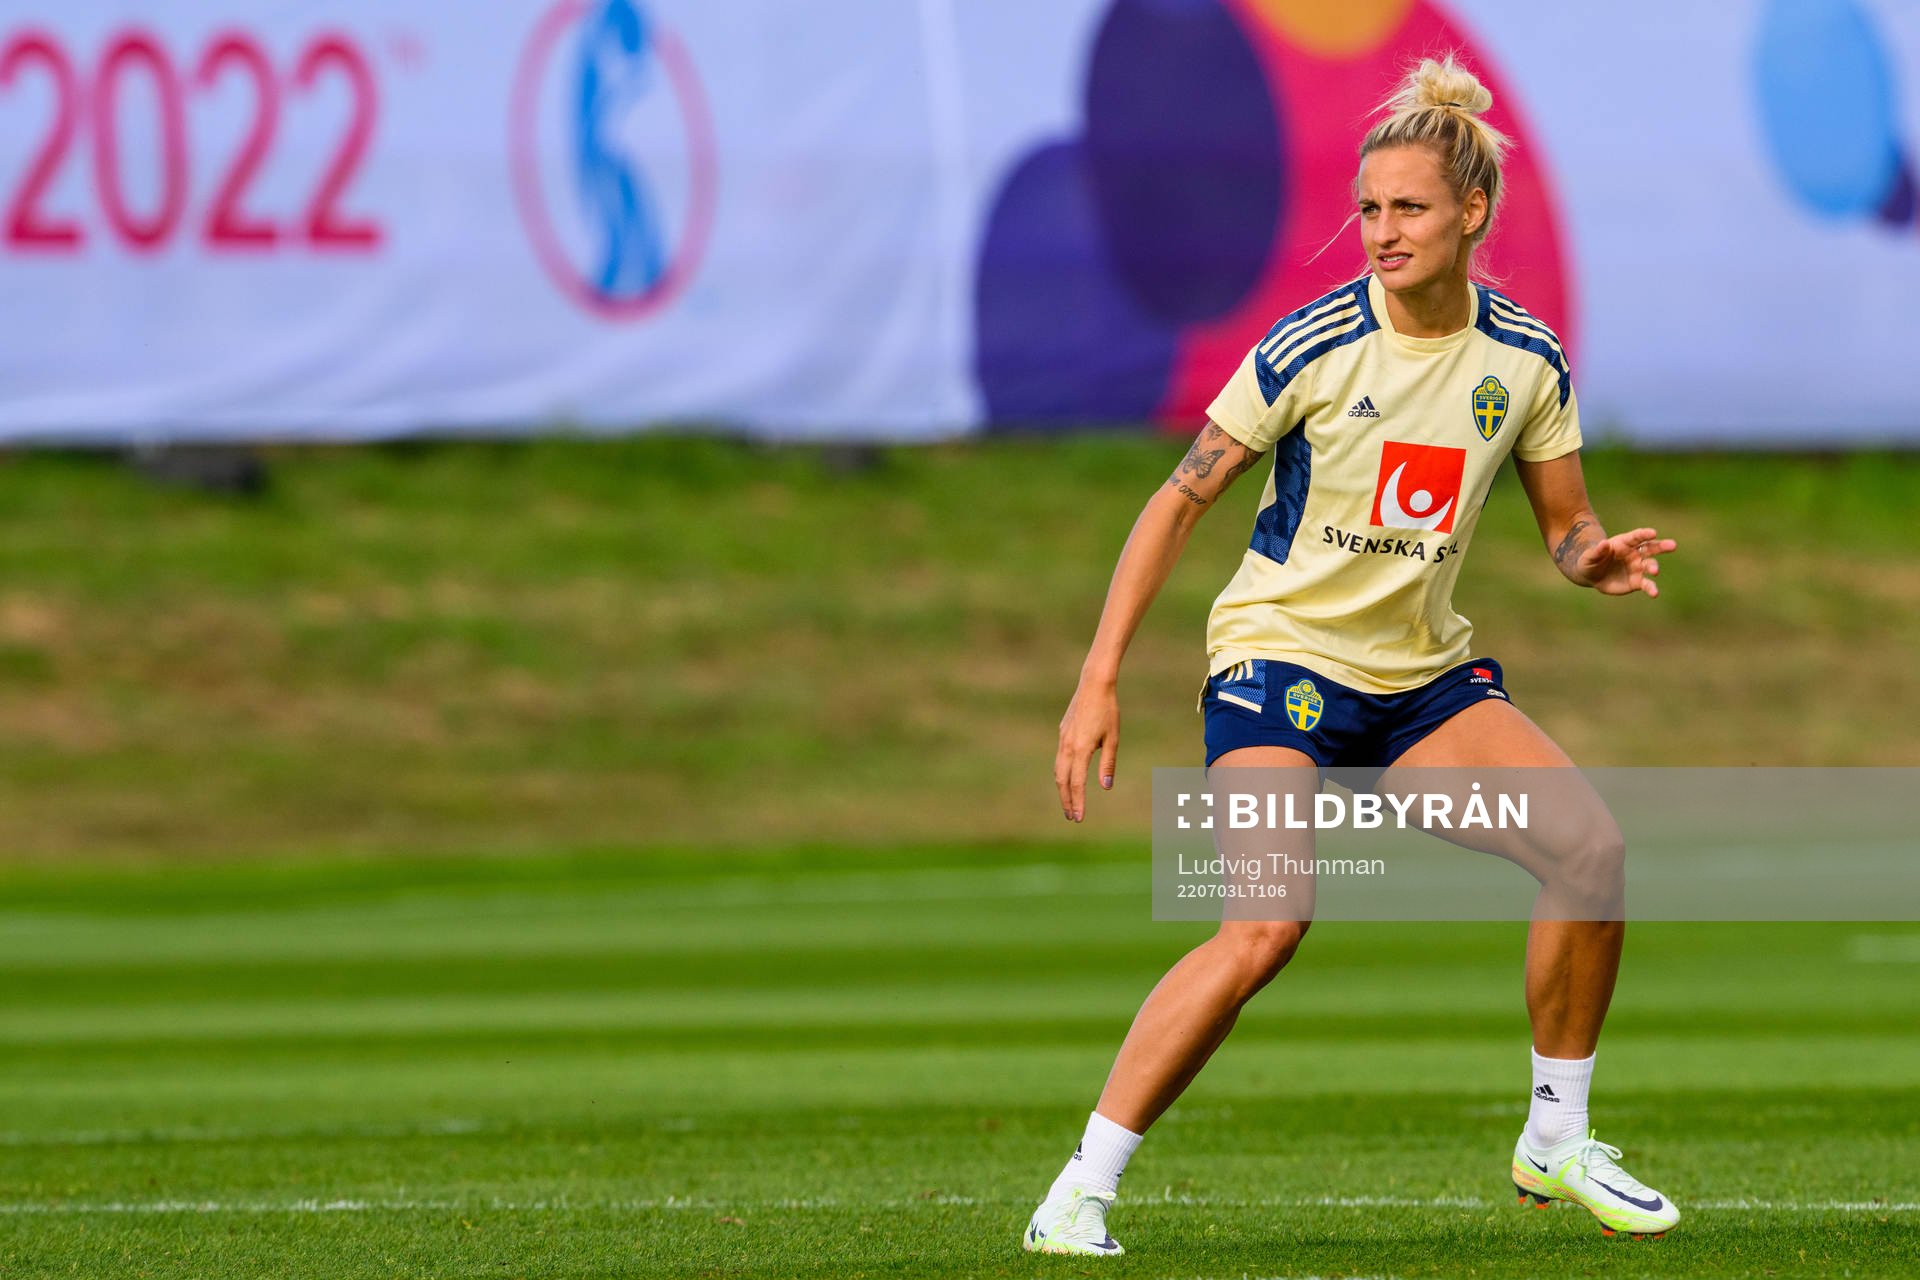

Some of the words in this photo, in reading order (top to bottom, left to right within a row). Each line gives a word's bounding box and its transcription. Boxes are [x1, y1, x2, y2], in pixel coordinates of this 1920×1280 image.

[0, 29, 384, 253] 2022
[1347, 409, 1381, 418] adidas
[1322, 525, 1426, 561] SVENSKA
